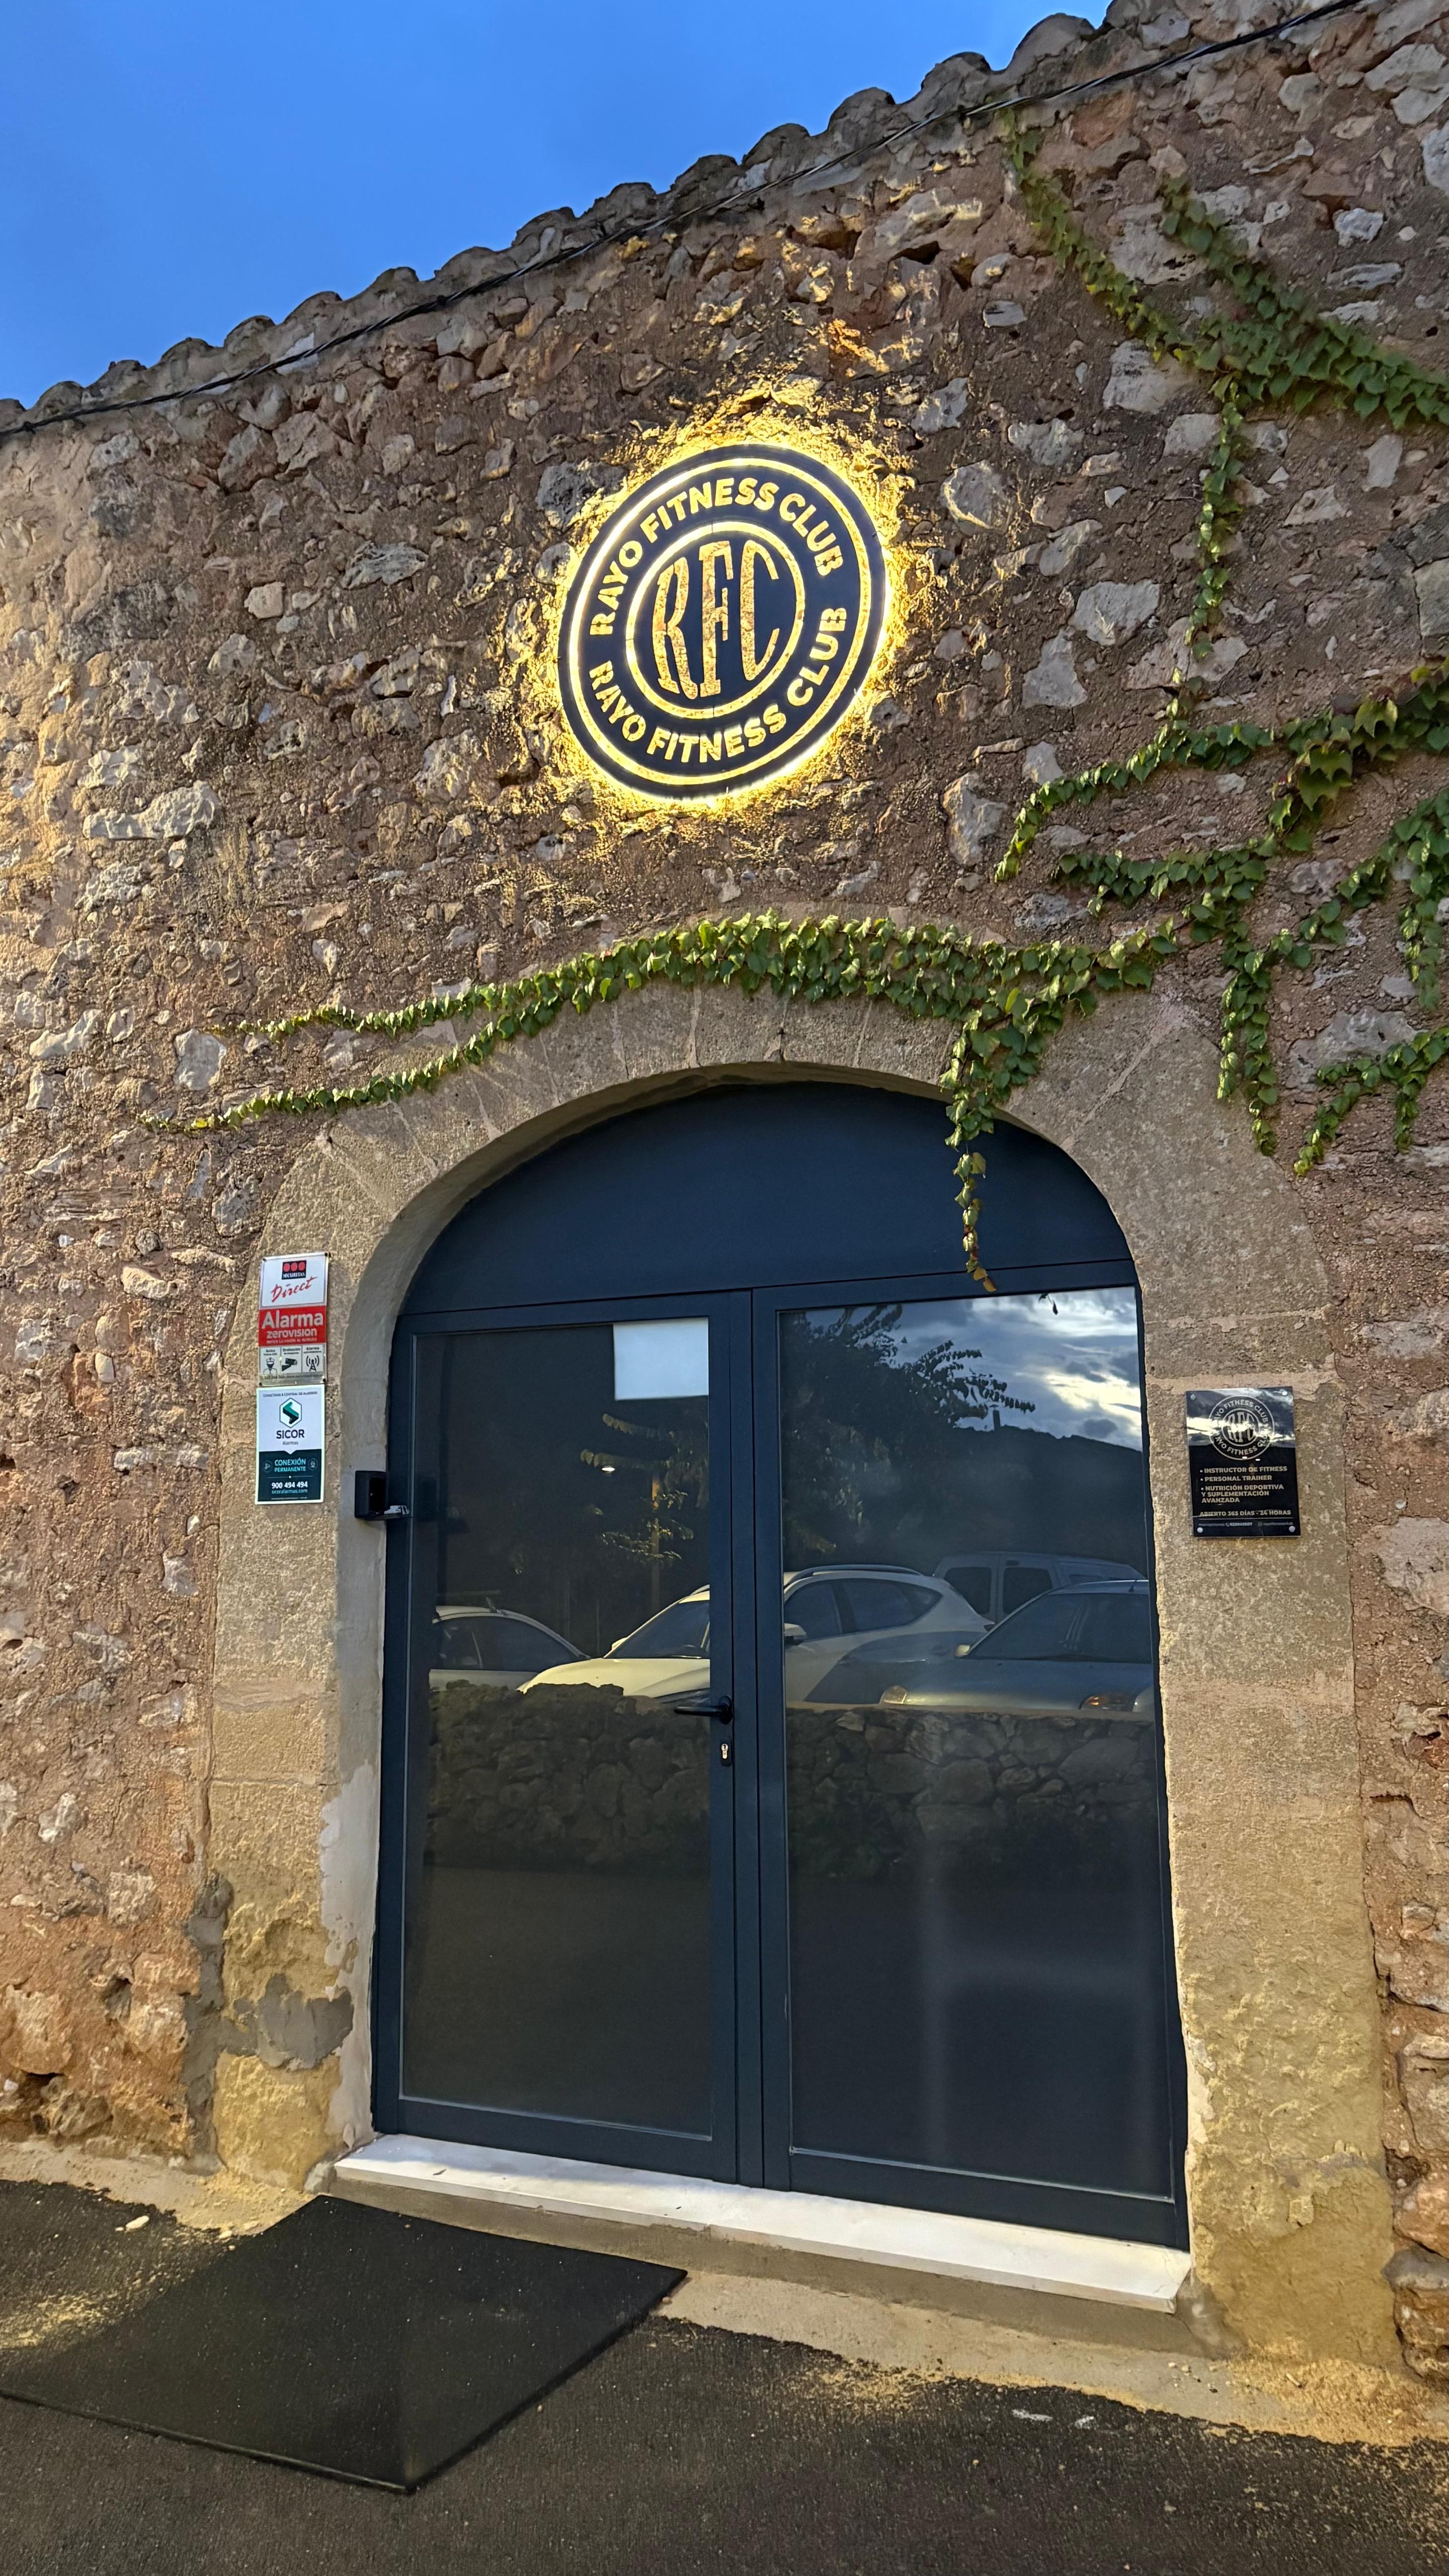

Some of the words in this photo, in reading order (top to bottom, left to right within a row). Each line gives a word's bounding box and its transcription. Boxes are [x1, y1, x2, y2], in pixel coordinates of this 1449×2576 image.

[590, 540, 643, 635] RAYO
[640, 477, 779, 544] FITNESS
[779, 493, 844, 576] CLUB
[652, 540, 779, 700] RFC
[590, 661, 647, 741] RAYO
[647, 703, 787, 763] FITNESS
[787, 607, 847, 707] CLUB
[271, 1276, 318, 1303] Direct
[261, 1310, 324, 1329] Alarma
[266, 1328, 317, 1339] zerovision
[1224, 1399, 1254, 1409] FITNESS
[1254, 1405, 1268, 1423] CLUB
[276, 1429, 305, 1439] SICOR
[1227, 1445, 1258, 1455] FITNESS
[274, 1457, 306, 1466] CONEXIÓN
